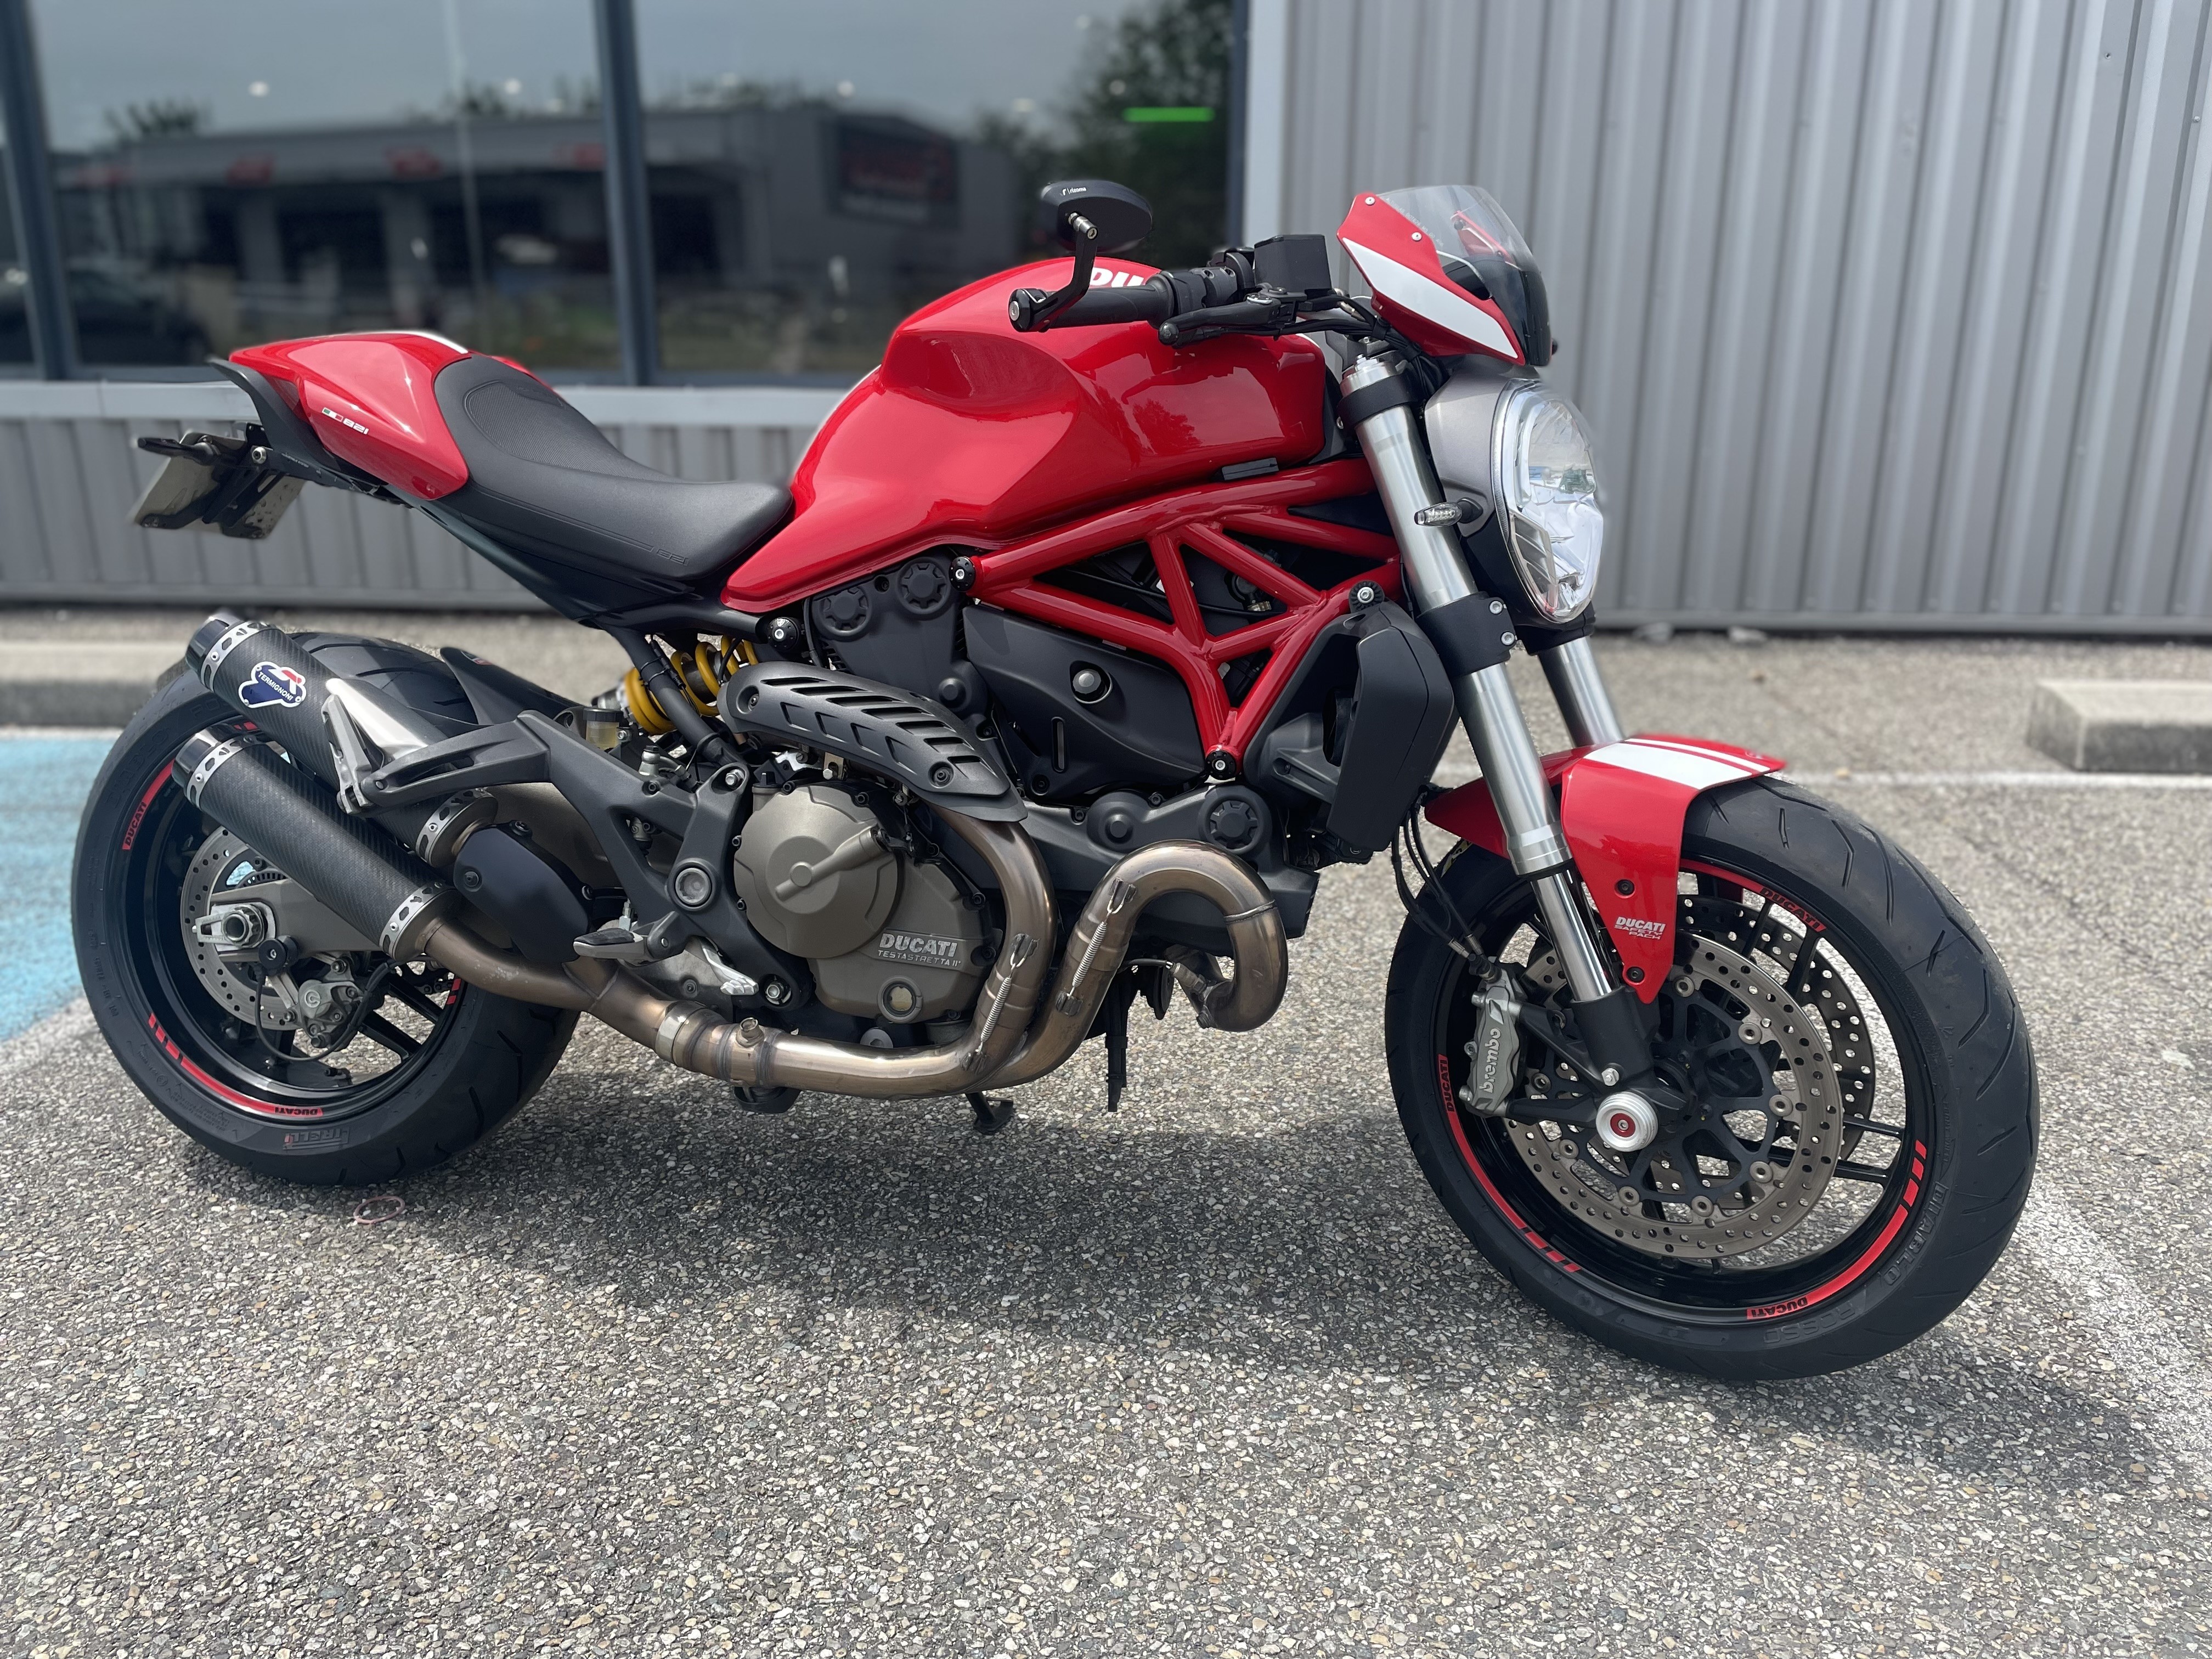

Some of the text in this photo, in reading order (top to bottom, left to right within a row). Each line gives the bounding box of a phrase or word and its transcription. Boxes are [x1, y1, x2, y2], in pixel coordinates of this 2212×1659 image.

[343, 417, 369, 435] 821
[258, 672, 294, 701] TERMIGNONI
[123, 801, 147, 847] DUCATI
[1759, 887, 1820, 929] DUCATI
[1615, 924, 1663, 935] SAFETY
[1616, 916, 1666, 932] DUCATI
[879, 933, 958, 957] DUCATI
[878, 949, 950, 966] TESTASTRETTA
[1479, 1027, 1502, 1094] brembo
[1440, 1059, 1455, 1112] DUCATI
[274, 1106, 319, 1117] DUCATI
[283, 1127, 351, 1151] PIRELLI
[1882, 1180, 1949, 1286] DIABLO
[1751, 1296, 1808, 1317] DUCATI
[1763, 1300, 1857, 1344] ROSSO
